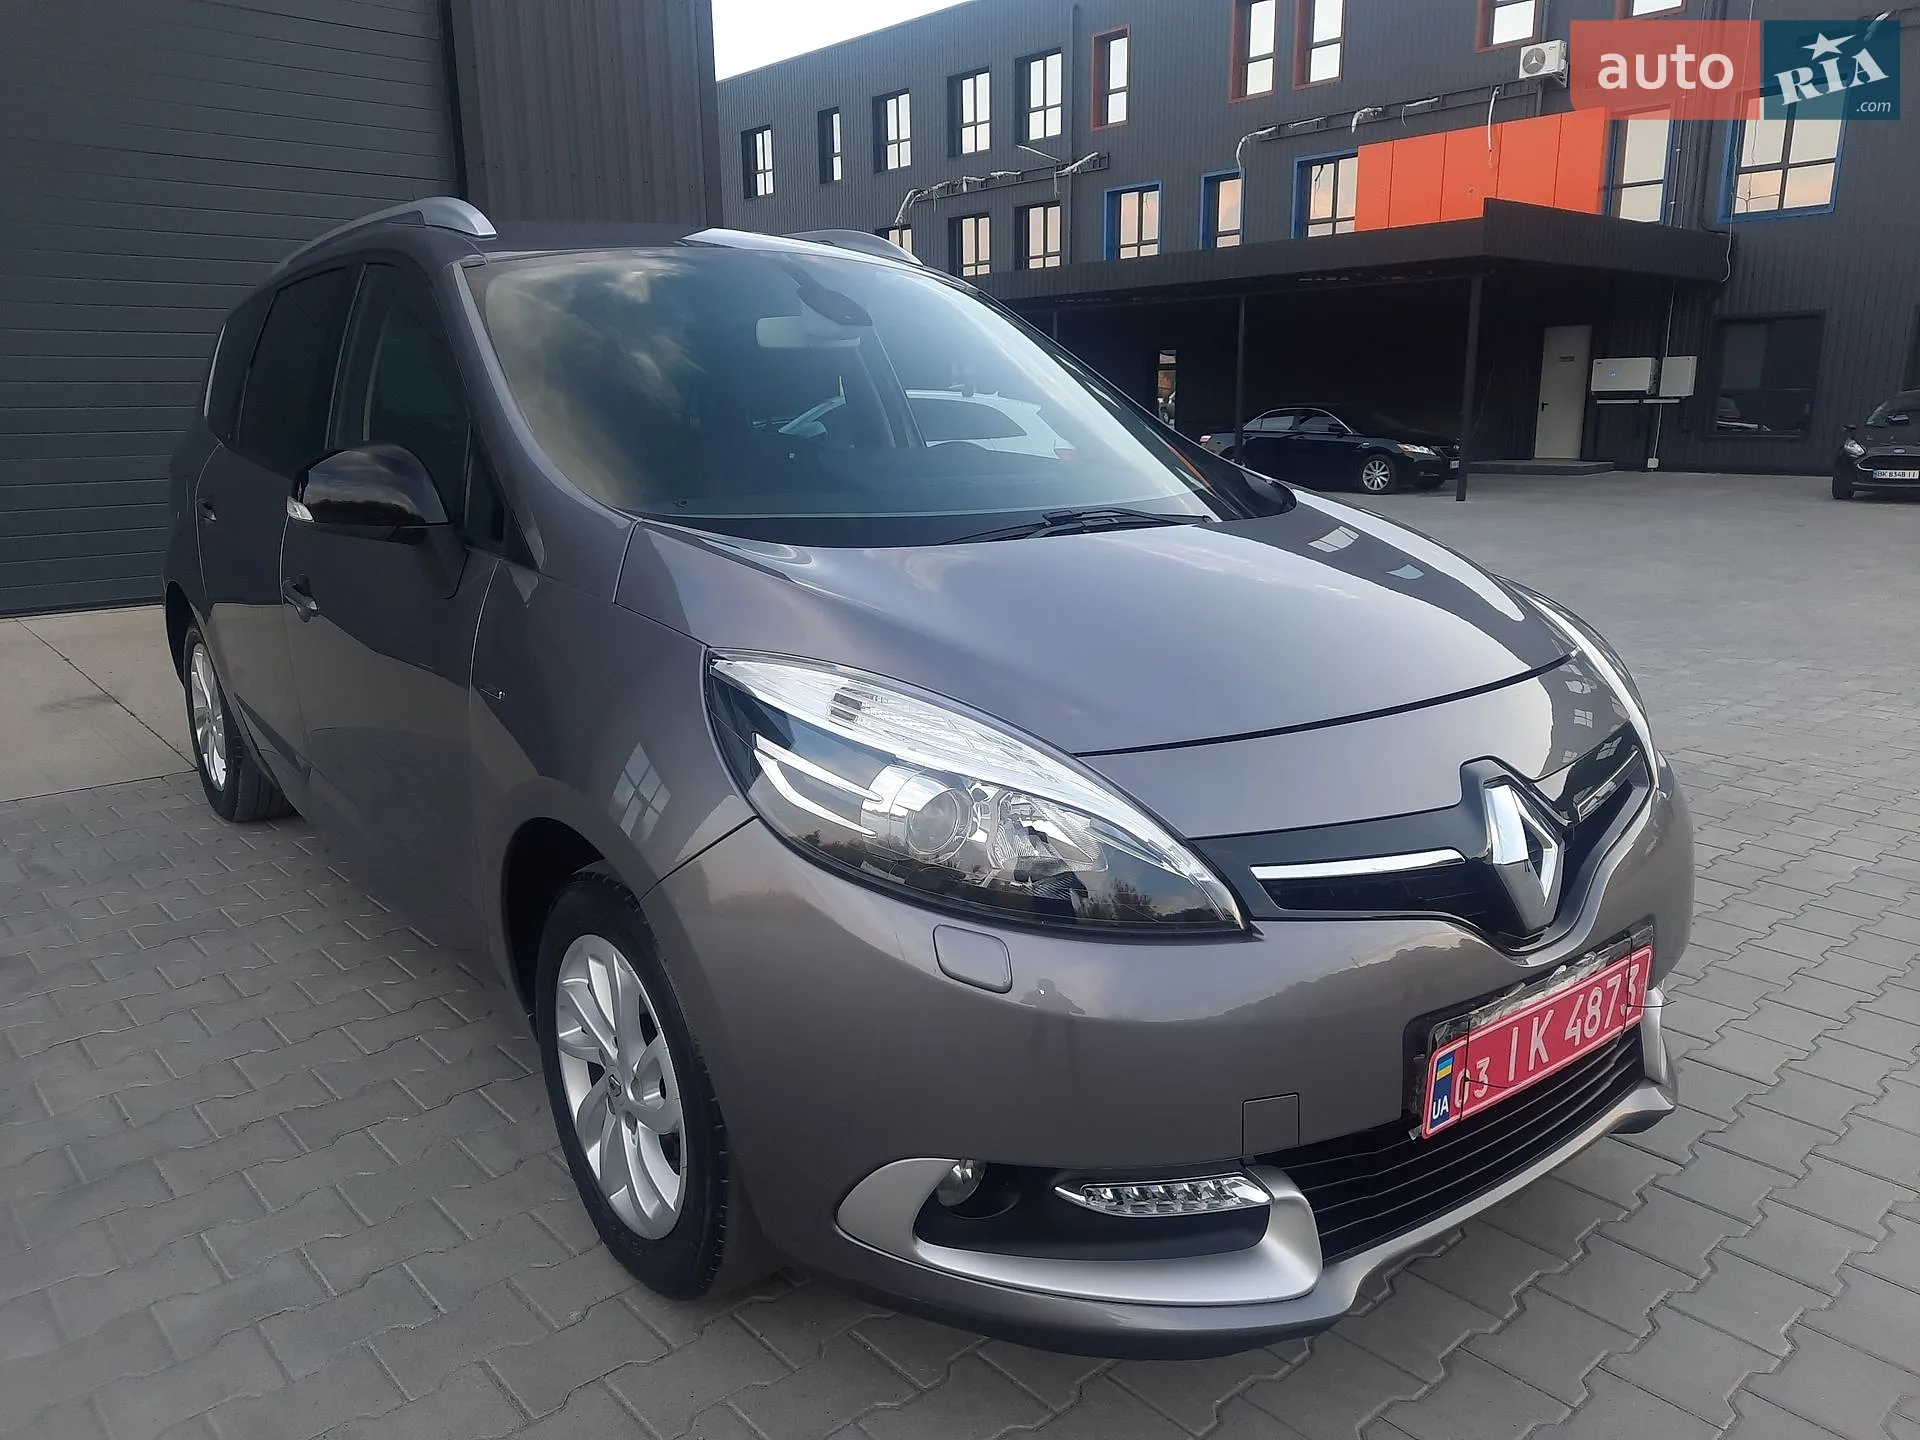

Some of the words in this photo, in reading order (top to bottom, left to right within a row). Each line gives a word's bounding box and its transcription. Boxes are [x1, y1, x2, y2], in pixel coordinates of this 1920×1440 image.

[1454, 1056, 1491, 1109] 03
[1508, 1009, 1554, 1083] IK
[1564, 963, 1640, 1047] 4873
[1432, 1094, 1450, 1120] UA
